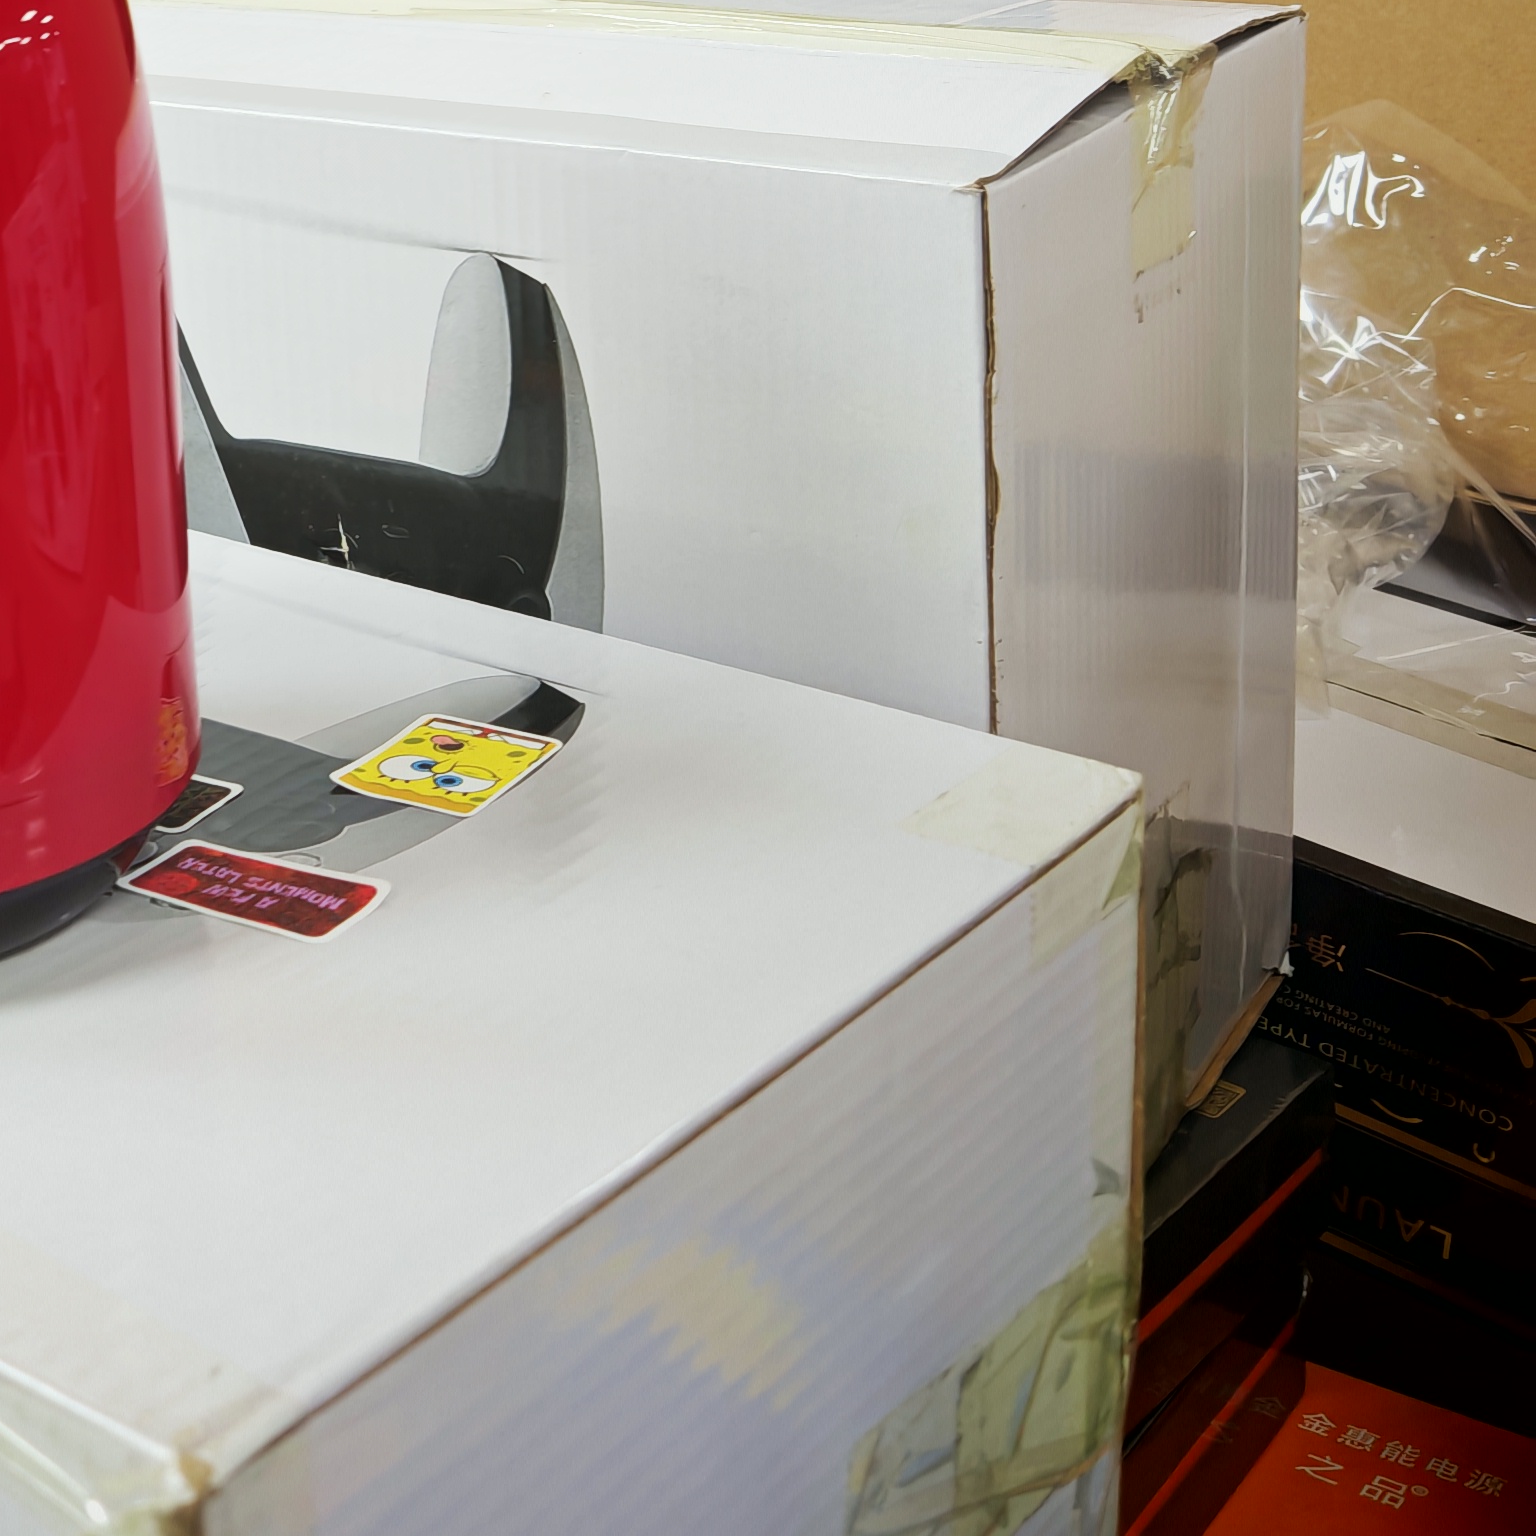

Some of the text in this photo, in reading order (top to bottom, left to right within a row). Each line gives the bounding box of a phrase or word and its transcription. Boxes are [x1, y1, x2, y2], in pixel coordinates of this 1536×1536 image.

[242, 876, 348, 911] MOMENTS
[254, 895, 280, 910] A
[1256, 1014, 1311, 1049] TYPE
[1318, 1041, 1514, 1133] CONCENTRATED
[1296, 1412, 1509, 1498] 金惠能电源
